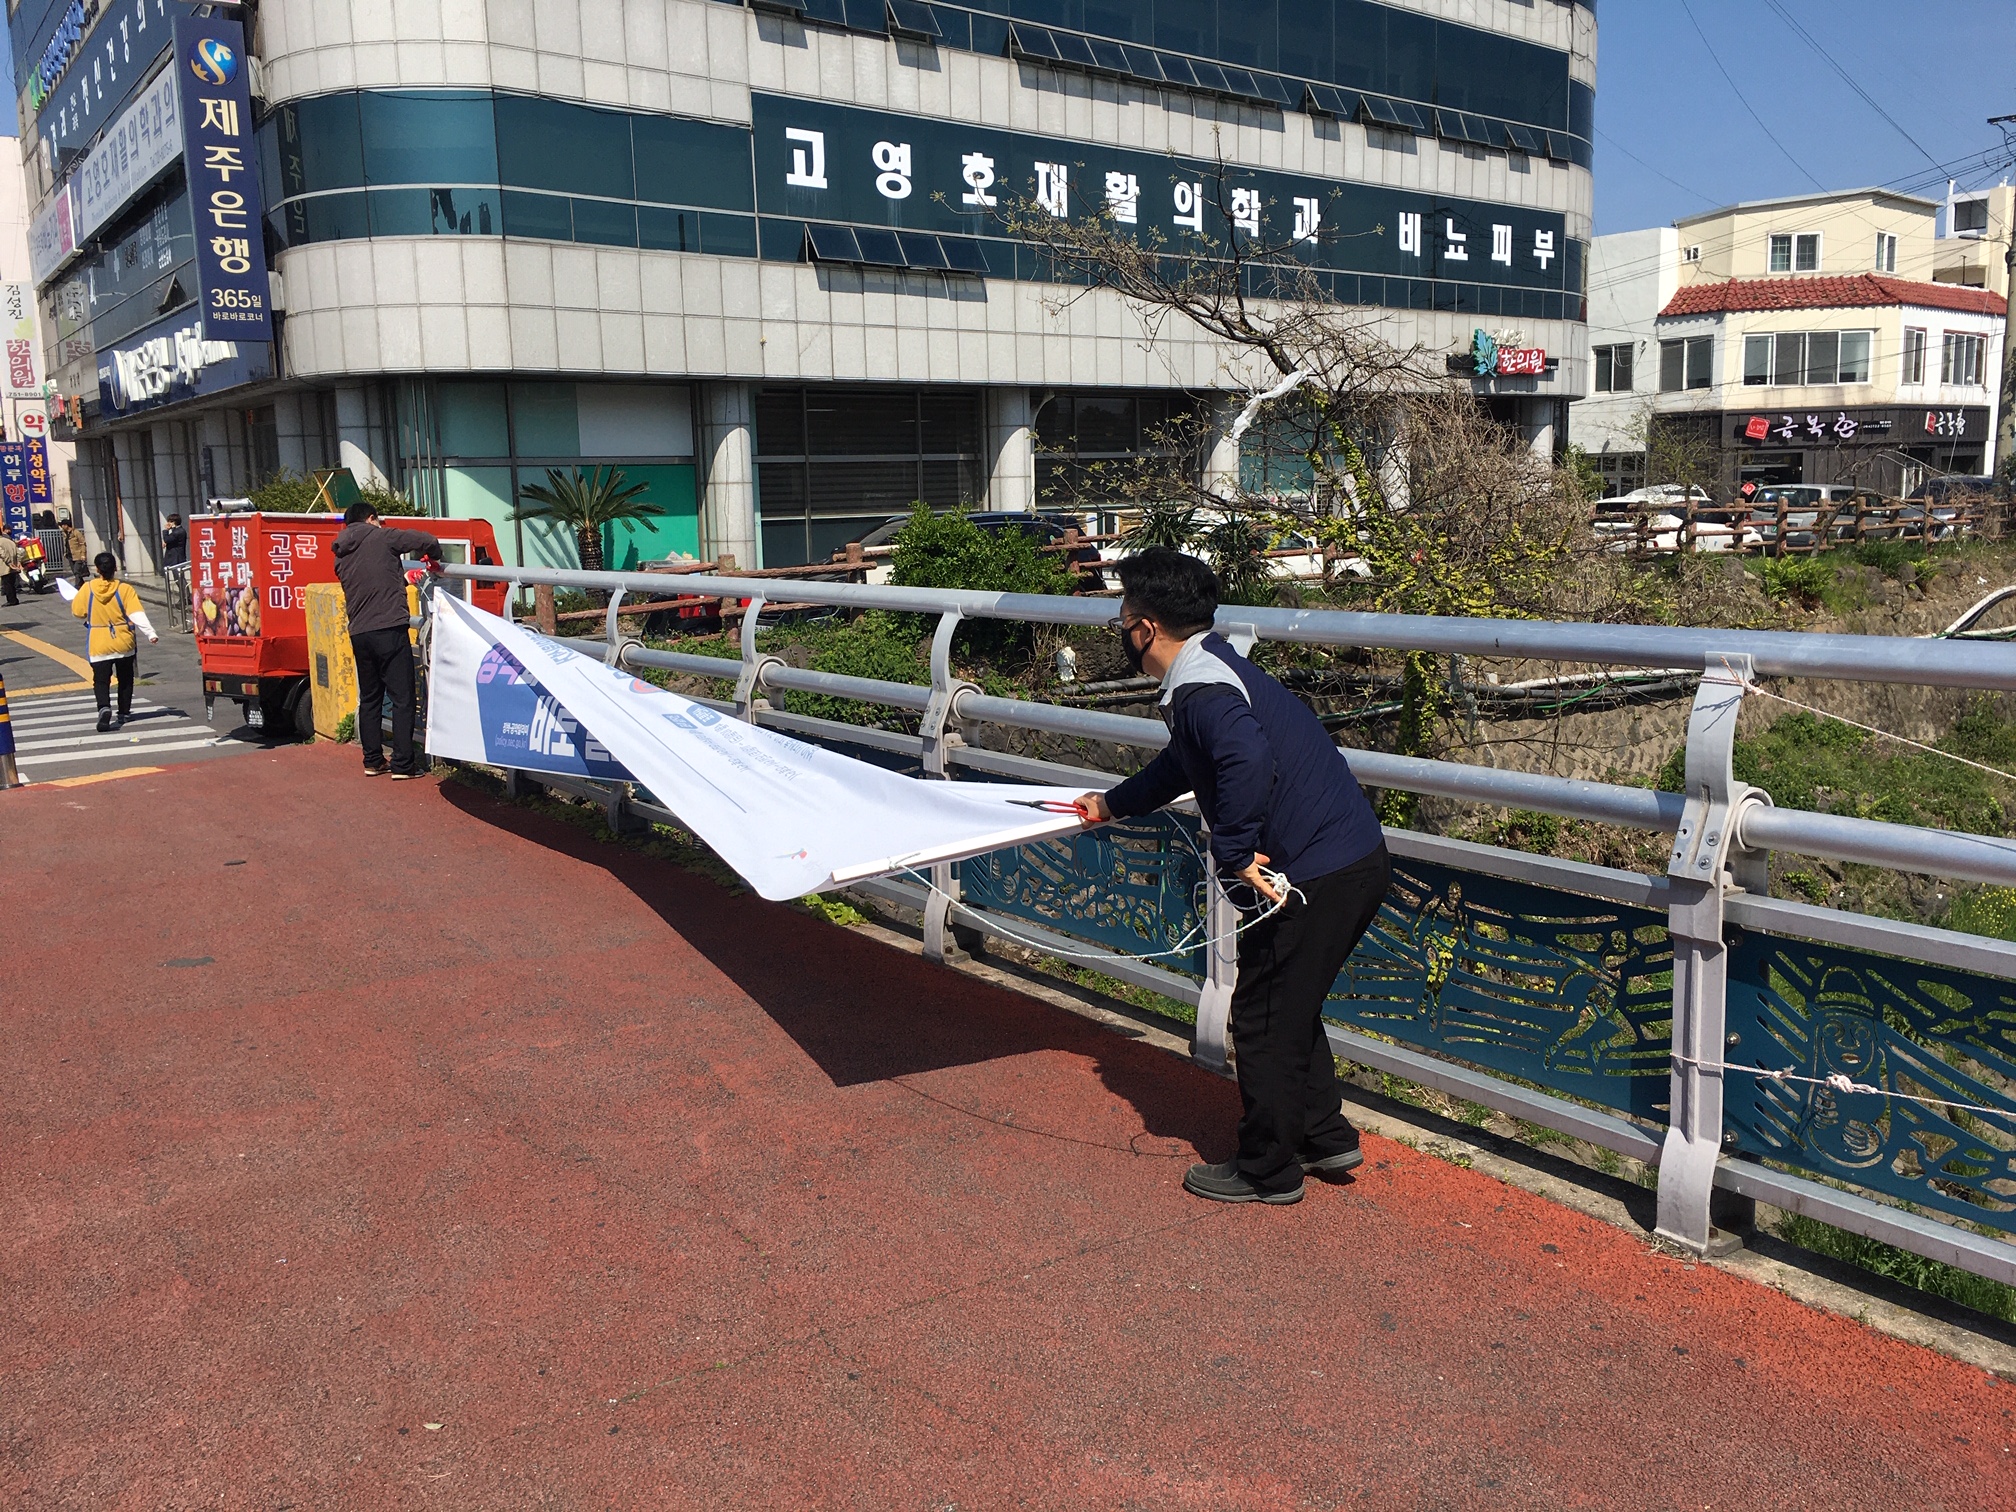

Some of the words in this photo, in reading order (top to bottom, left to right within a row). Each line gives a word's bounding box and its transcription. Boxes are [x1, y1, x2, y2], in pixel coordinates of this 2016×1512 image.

[199, 98, 251, 274] 제주은행
[1398, 211, 1556, 271] 비뇨피부
[5, 284, 24, 320] 김성진
[211, 288, 262, 309] 365일
[212, 311, 263, 322] 바로바로코너
[6, 339, 35, 387] 한의원
[1500, 350, 1544, 374] 한의원
[23, 414, 45, 433] 약
[199, 562, 253, 588] 고구마
